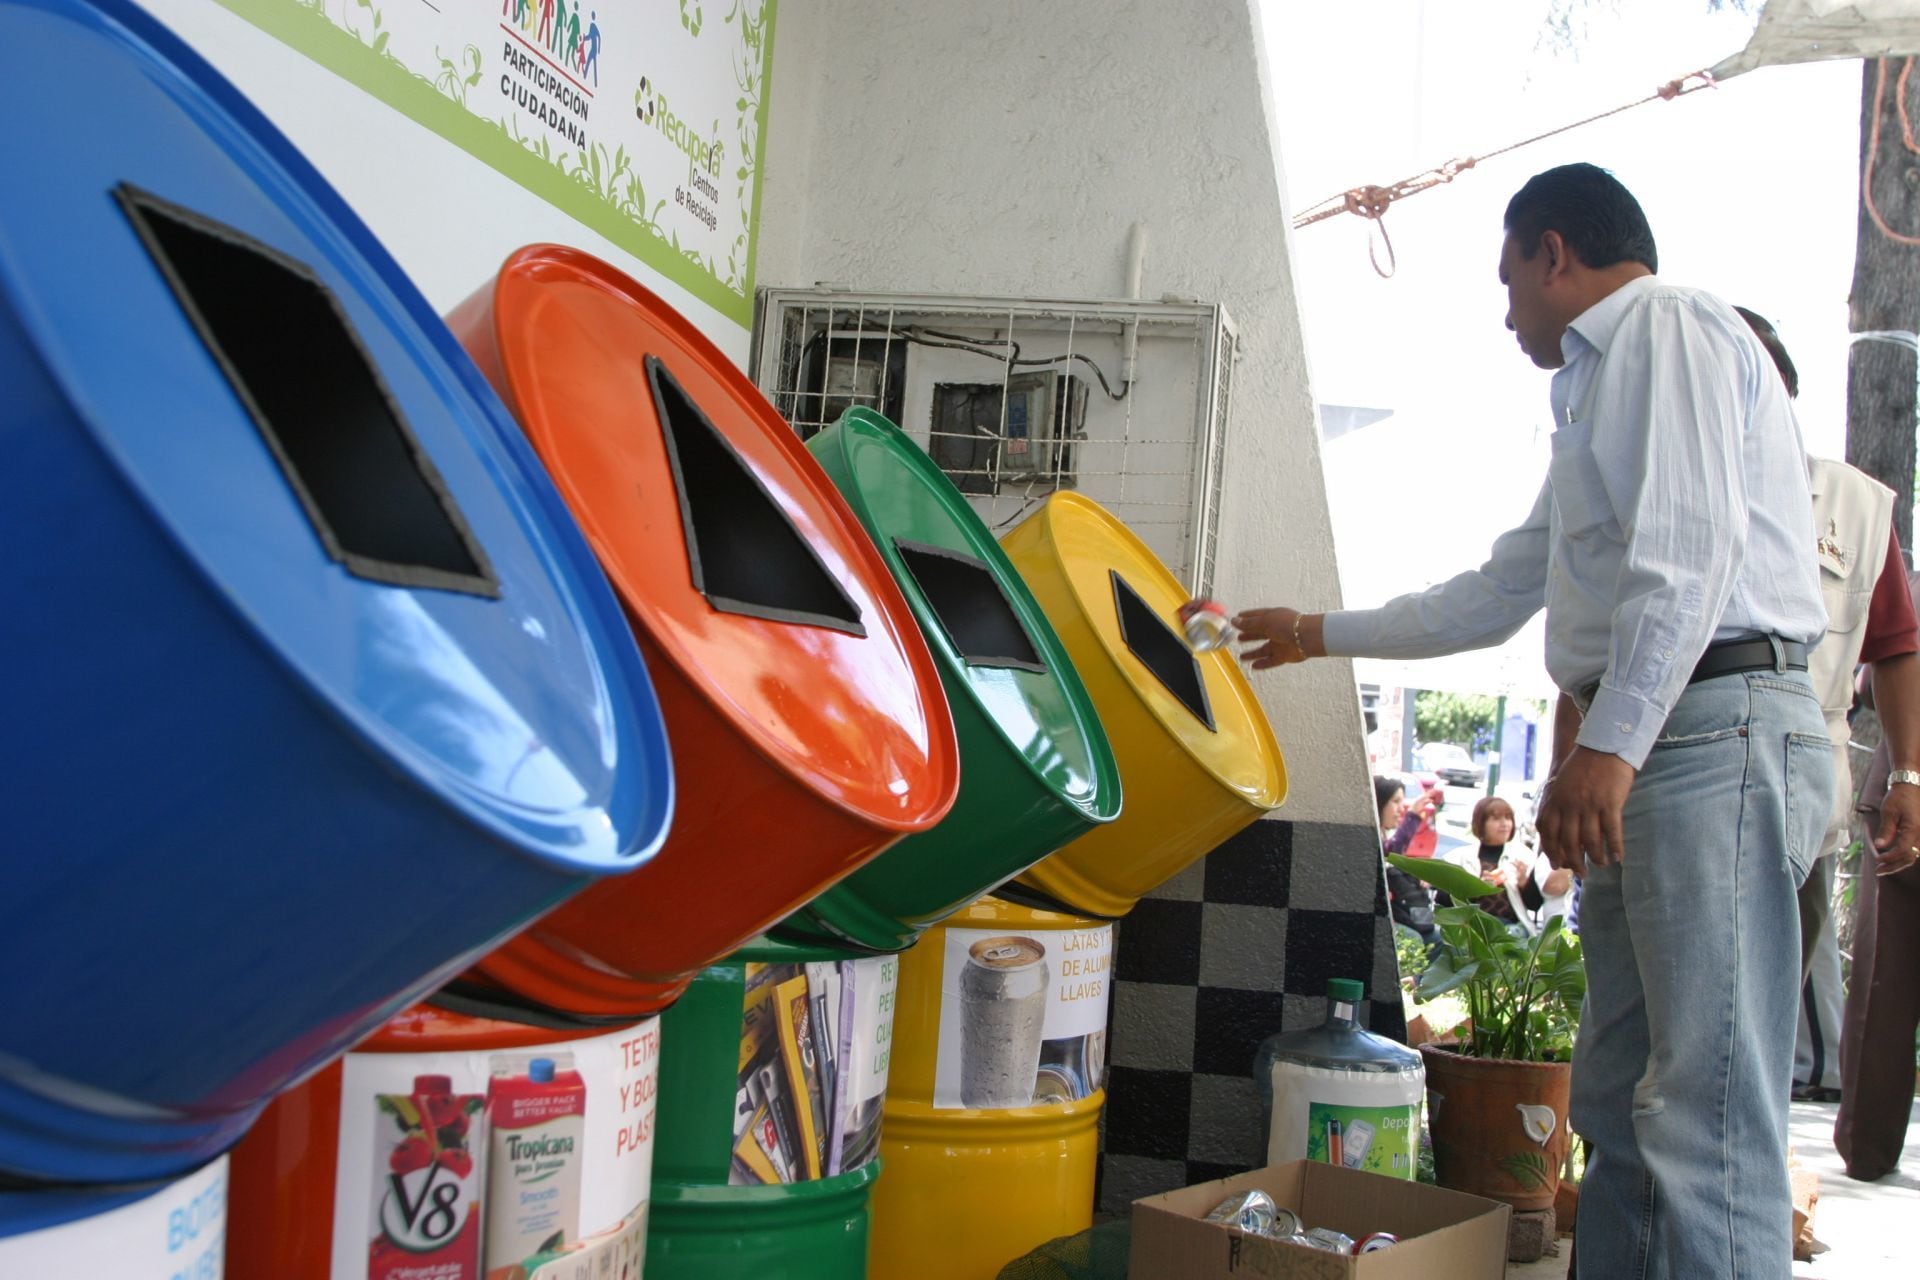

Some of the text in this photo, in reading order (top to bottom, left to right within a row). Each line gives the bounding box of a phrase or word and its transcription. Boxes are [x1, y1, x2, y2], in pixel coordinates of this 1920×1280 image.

[503, 41, 588, 122] PARTICIPACIÓN
[500, 74, 586, 151] CIUDADANA
[692, 167, 719, 204] Centros
[674, 185, 717, 232] de Reciclaje
[1063, 932, 1099, 952] LATAS
[1062, 959, 1081, 977] DE
[1060, 979, 1103, 1002] LLAVES
[620, 1083, 631, 1114] Y
[506, 1133, 574, 1161] Tropicana
[390, 1157, 459, 1241] V8
